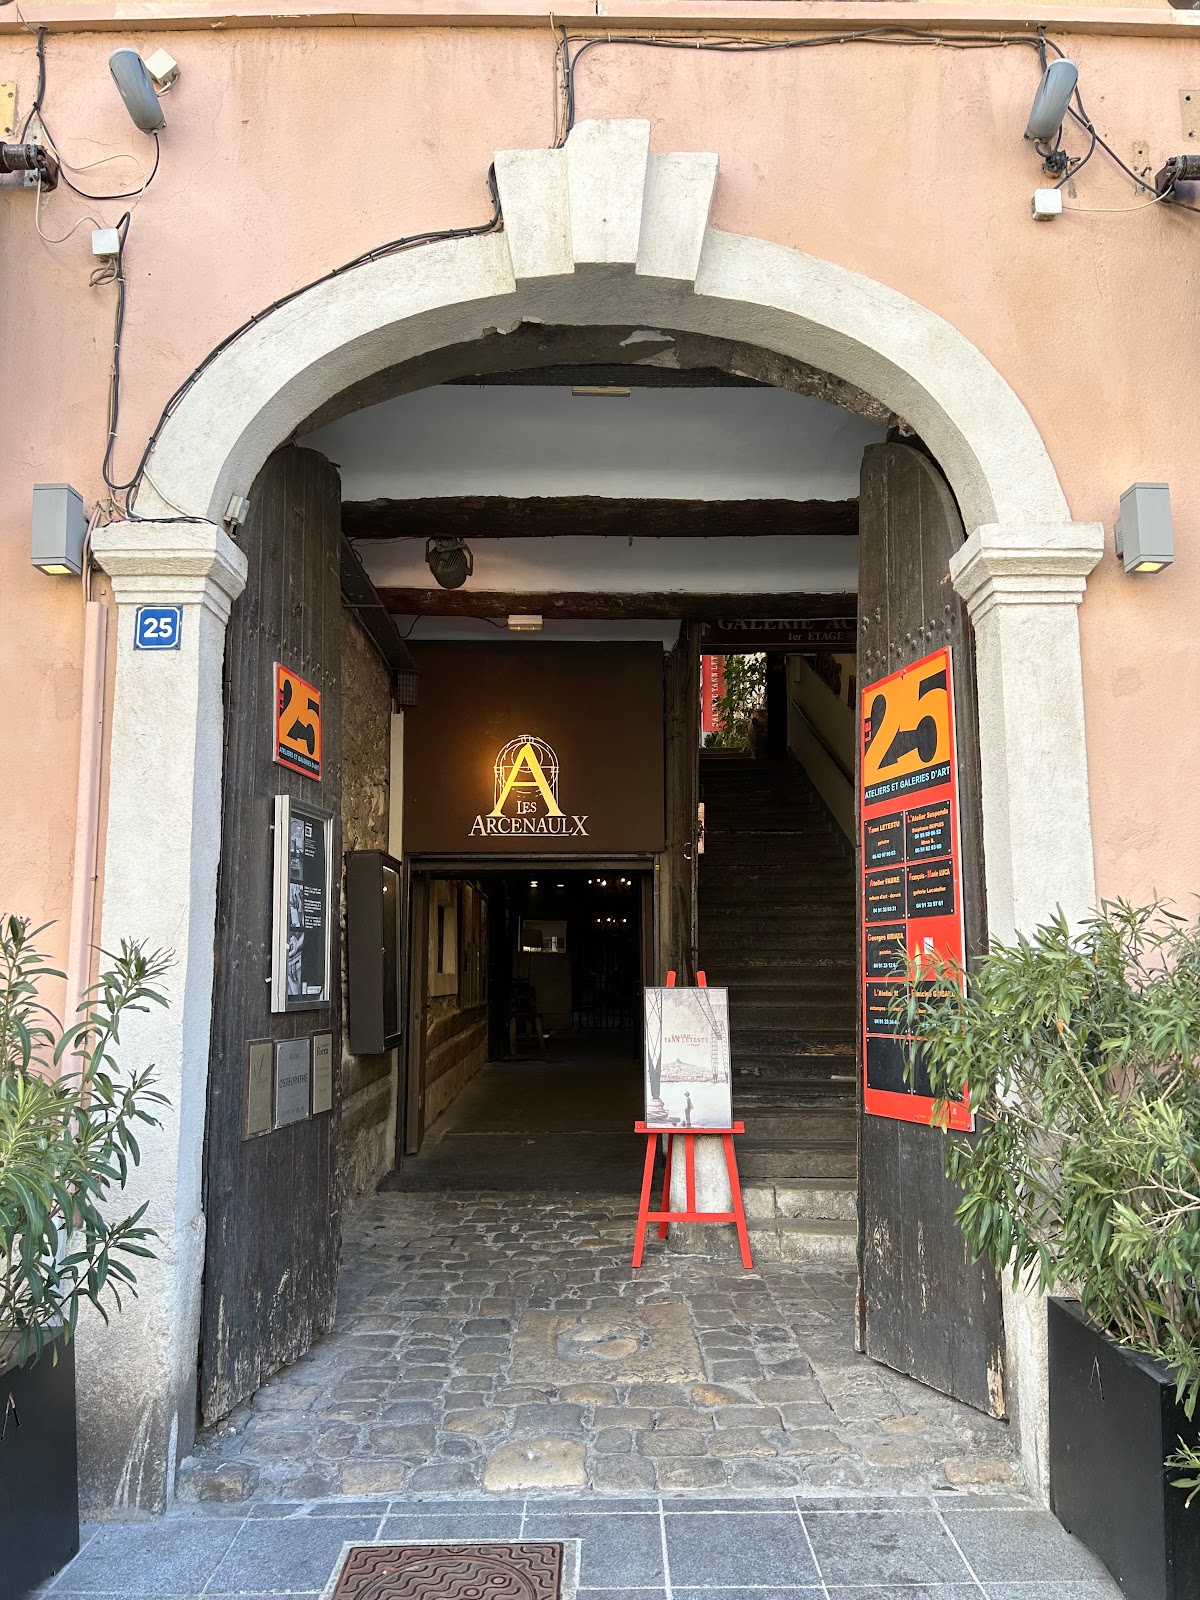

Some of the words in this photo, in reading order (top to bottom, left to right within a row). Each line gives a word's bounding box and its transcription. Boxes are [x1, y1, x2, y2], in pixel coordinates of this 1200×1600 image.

[143, 617, 173, 638] 25
[788, 632, 803, 641] 1er
[808, 631, 844, 641] ETAGE
[711, 673, 719, 693] YANN
[864, 668, 948, 770] 25
[486, 742, 567, 817] A
[865, 785, 891, 799] ATELIERS
[891, 781, 900, 792] ET
[899, 773, 930, 788] GALERIES
[930, 766, 951, 780] D'ART
[516, 800, 537, 815] LES
[467, 814, 590, 838] ARCENAULX
[880, 821, 900, 831] LETESTU
[907, 813, 927, 823] L'Atelier
[869, 878, 885, 887] Atelier
[867, 933, 886, 943] Georges
